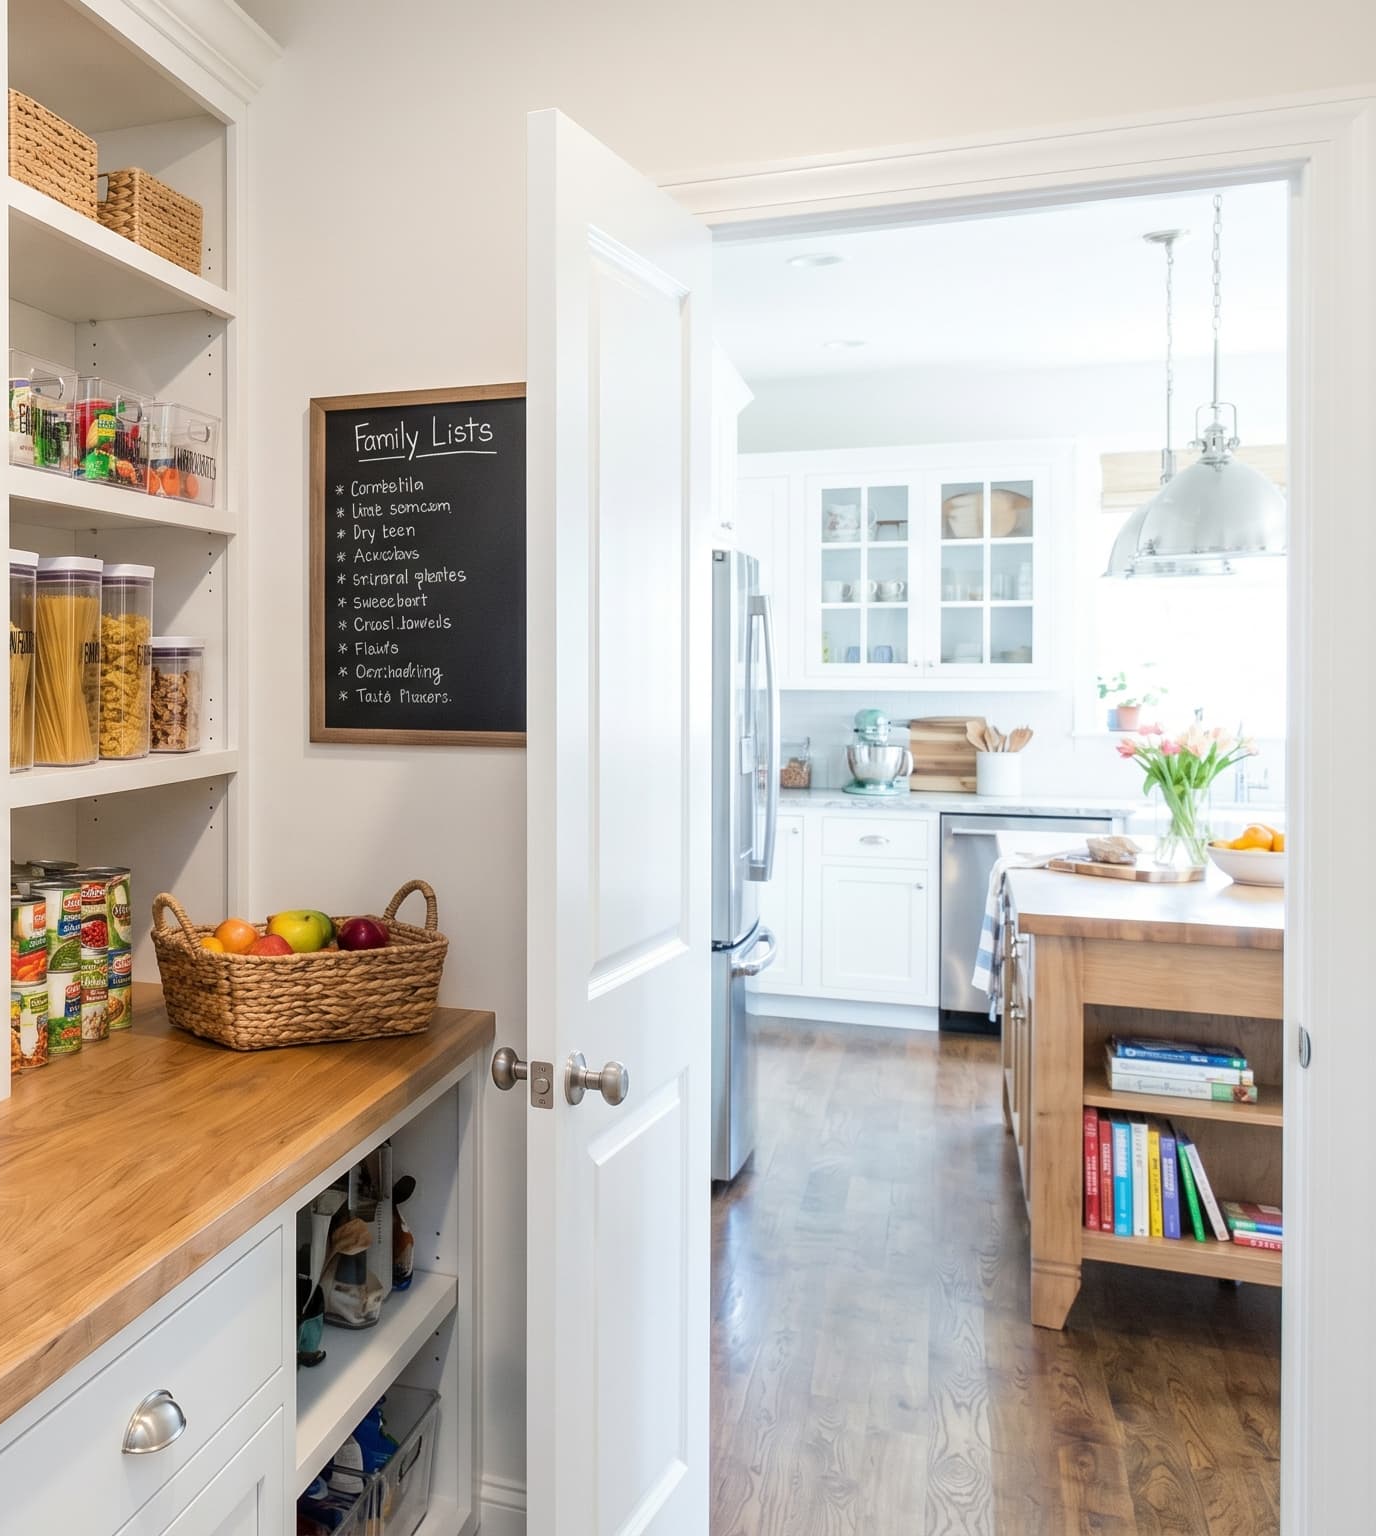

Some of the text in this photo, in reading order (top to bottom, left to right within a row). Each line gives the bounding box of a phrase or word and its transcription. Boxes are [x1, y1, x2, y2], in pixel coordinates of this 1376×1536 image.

[355, 415, 493, 461] Family Lists
[353, 524, 415, 544] Dry teen
